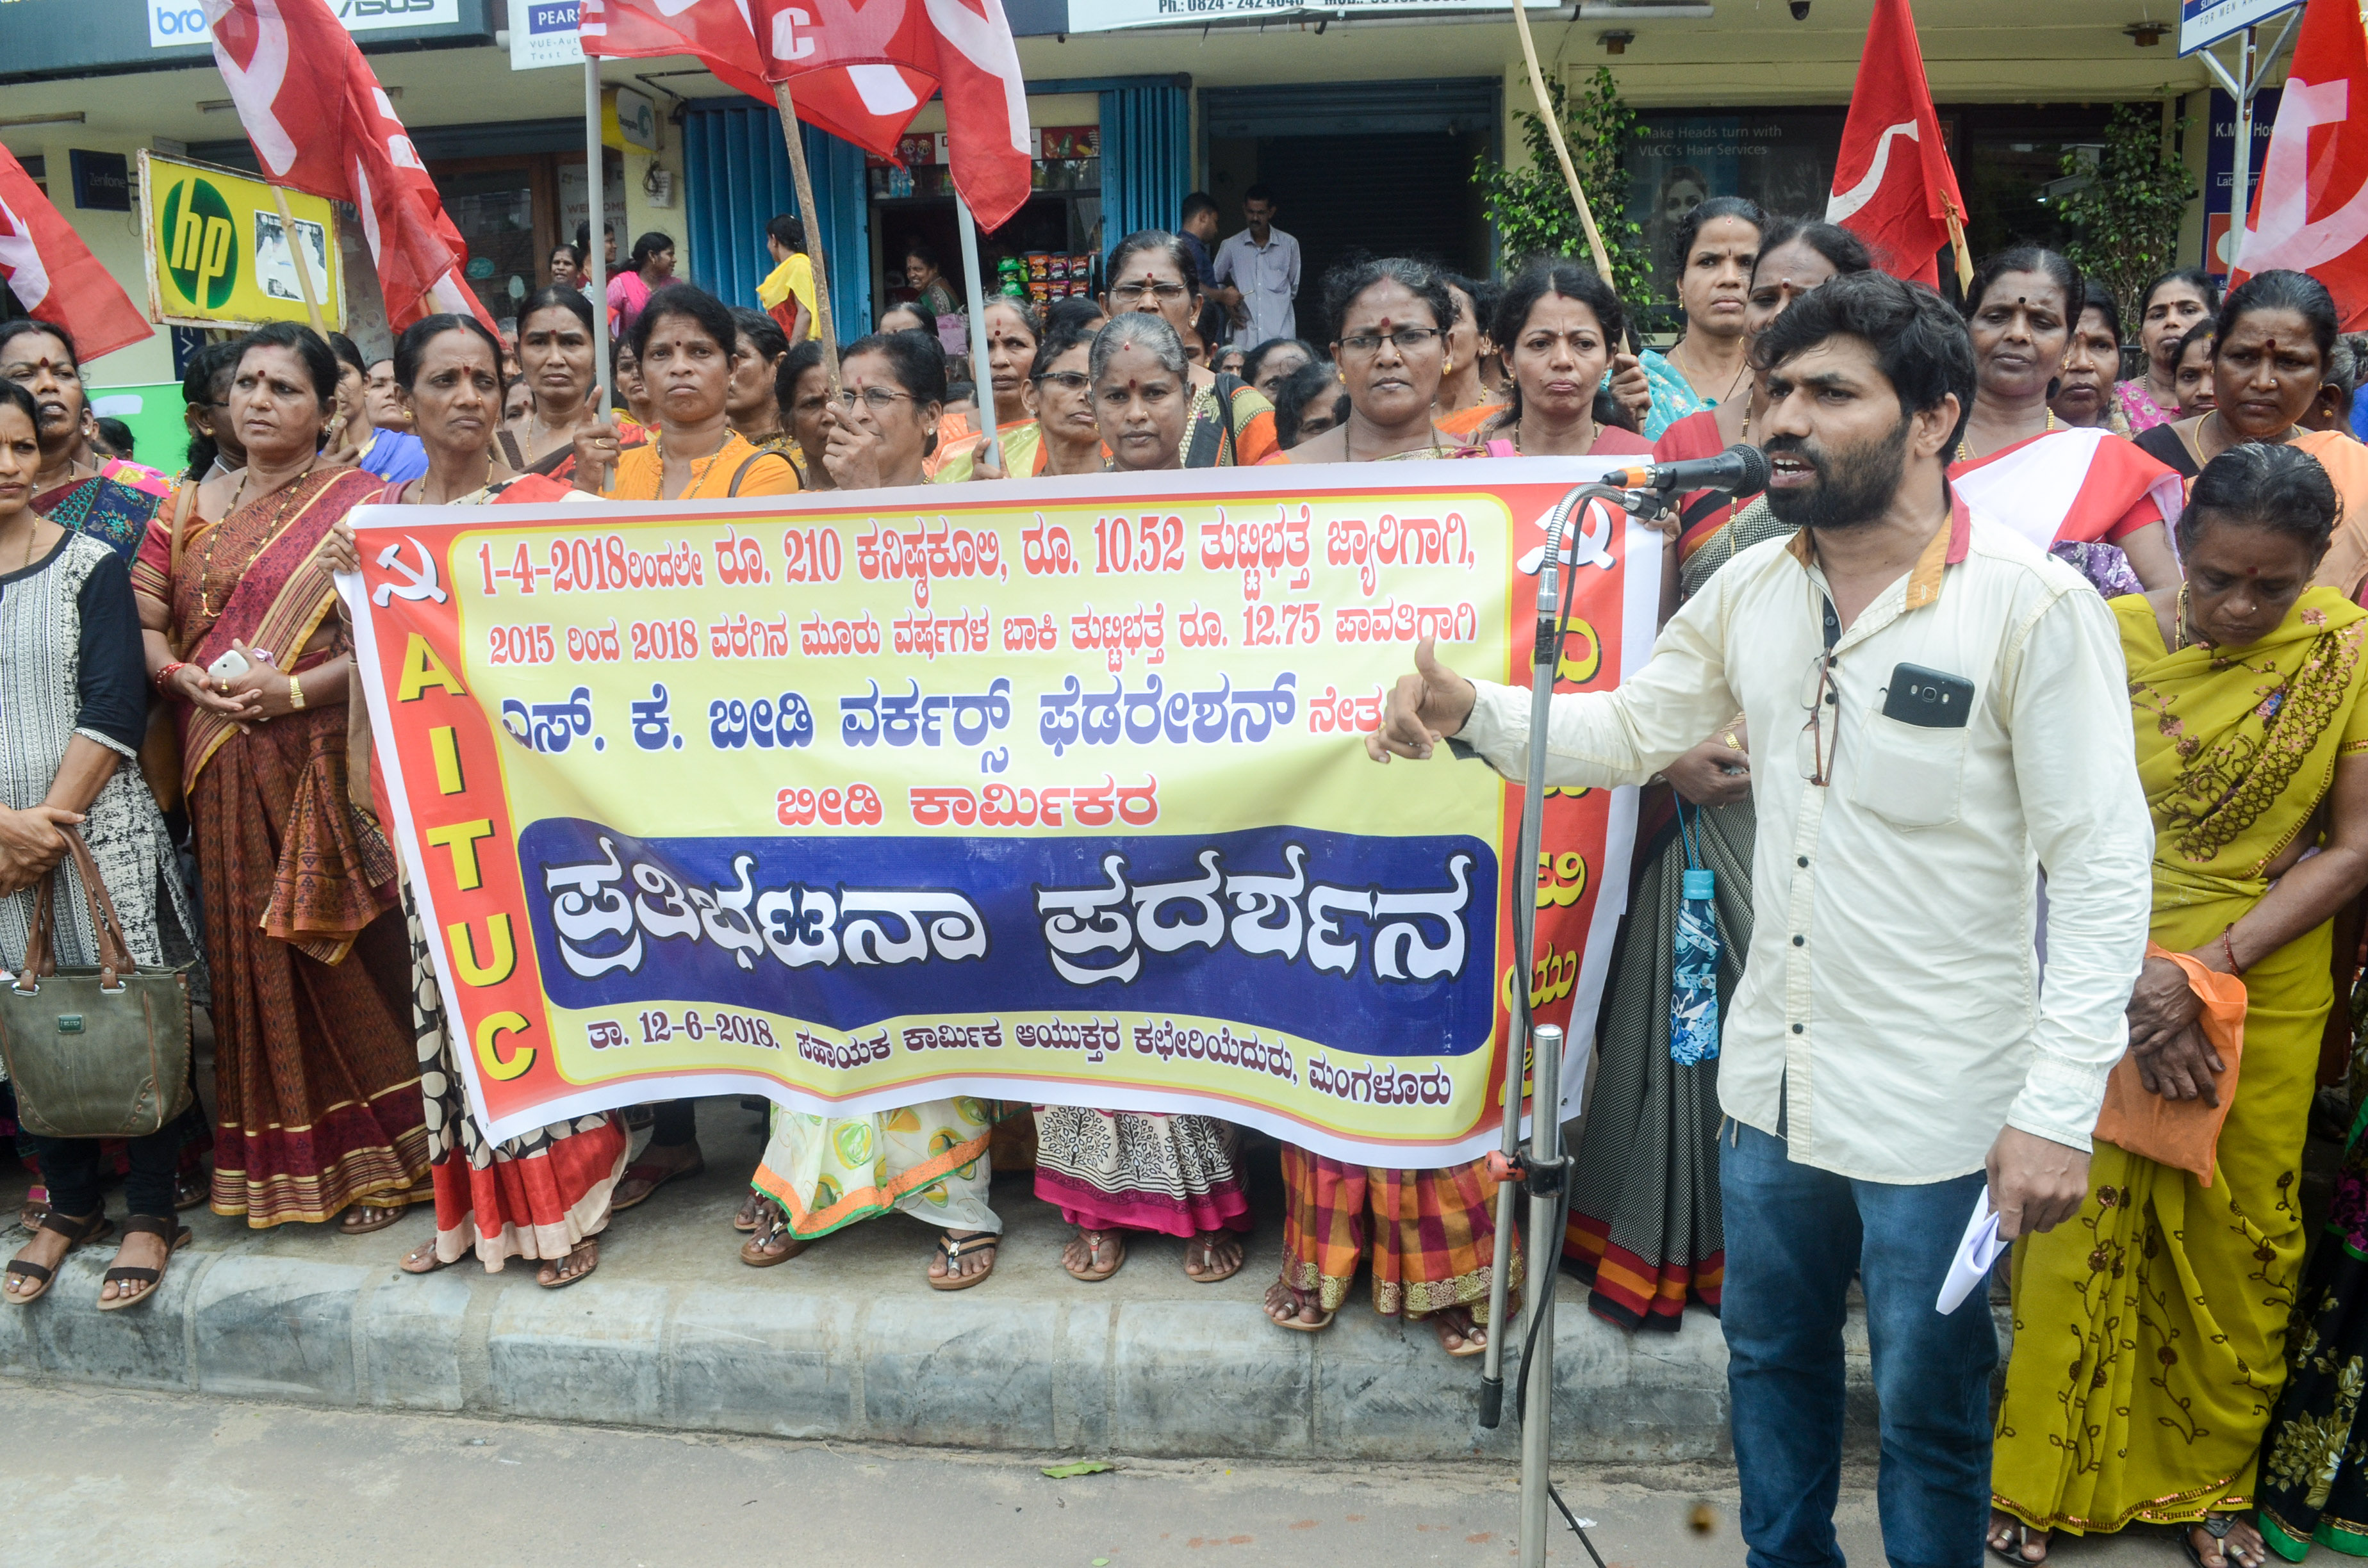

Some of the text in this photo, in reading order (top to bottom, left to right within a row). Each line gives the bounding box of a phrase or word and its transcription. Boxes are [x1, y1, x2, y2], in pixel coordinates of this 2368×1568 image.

[157, 7, 207, 35] bro
[2199, 13, 2214, 27] FOR
[2219, 4, 2236, 17] MEN
[530, 37, 577, 49] VUE-Aut
[531, 51, 561, 61] Test
[1679, 127, 1717, 138] Heads
[1722, 127, 1748, 138] turn
[1753, 125, 1782, 137] with
[1687, 144, 1713, 156] Hair
[1717, 143, 1768, 155] Services
[89, 172, 126, 188] Zenfone
[170, 177, 232, 310] hp
[715, 525, 771, 584] ರೂ.
[784, 528, 841, 582] 210
[1022, 514, 1078, 575] ರೂ.
[1094, 516, 1185, 573] 10.52
[490, 625, 555, 664] 2015
[568, 618, 620, 662] ರಿಂದ
[631, 619, 699, 660] 2018
[711, 613, 789, 658] ವರೆಗಿನ
[801, 610, 881, 655] ಮೂರು
[893, 607, 989, 660] ವರ್ಷಗಳ
[1004, 614, 1058, 651] ಬಾಕಿ
[1179, 602, 1228, 648] ರೂ.
[1244, 603, 1320, 646] 12.75
[1336, 596, 1476, 642] ಪಾವತಿಗಾಗಿ
[502, 687, 605, 753] ಎಸ್.
[631, 683, 683, 751] ಕೆ.
[709, 692, 814, 749] ಬೀಡಿ
[1040, 672, 1296, 757] ಫೆಡರೇಶನ್
[777, 774, 1158, 827] ಬೀಡಿ ಕಾರ್ಮಿಕರ
[545, 836, 1471, 984] ಪ್ರತಿಭಟನಾ ಪ್ರದರ್ಶನ
[588, 1011, 1451, 1106] ತಾ. 12-6-2018. ಸಹಾಯಕ ಕಾರ್ಮಿಕ ಆಯುಕ್ತರ ಕಛೇರಿಯೆದುರು, ಮಂಗಳೂರು
